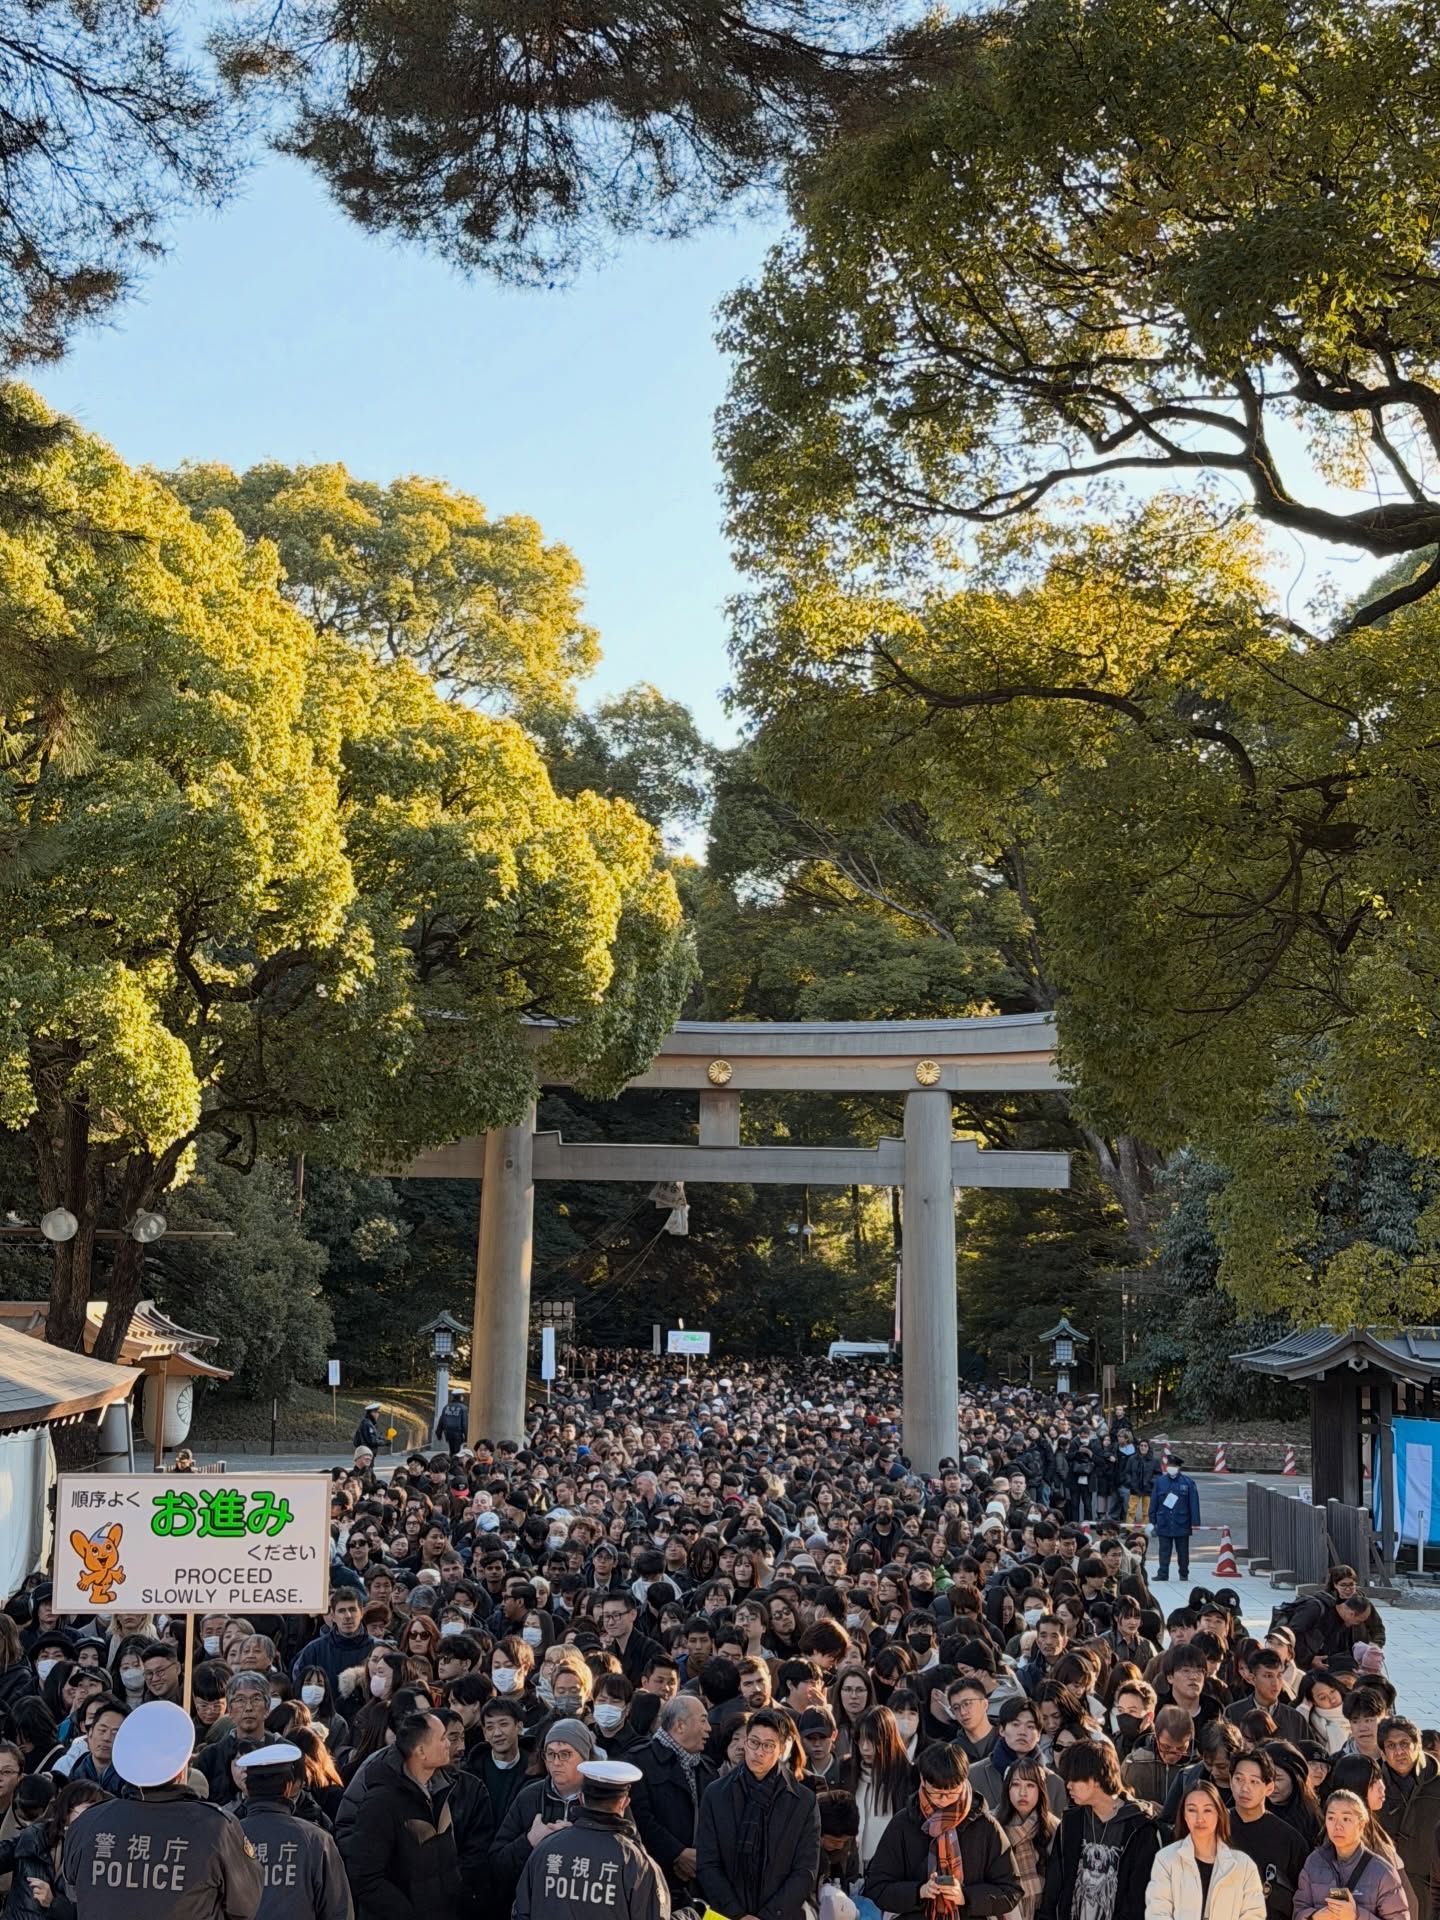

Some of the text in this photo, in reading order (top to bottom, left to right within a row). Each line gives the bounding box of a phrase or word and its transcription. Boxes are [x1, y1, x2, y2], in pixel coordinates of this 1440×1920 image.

[71, 1490, 140, 1508] 順序よく
[151, 1488, 294, 1538] お進み
[247, 1544, 316, 1561] ください
[174, 1568, 273, 1585] PROCEED
[141, 1589, 303, 1604] SLOWLY PLEASE.
[94, 1832, 190, 1863] 警視庁
[252, 1842, 299, 1863] 視庁
[92, 1860, 186, 1891] POLICE
[264, 1864, 297, 1887] ICE
[546, 1853, 619, 1882] 警視庁
[545, 1876, 616, 1905] POLICE
